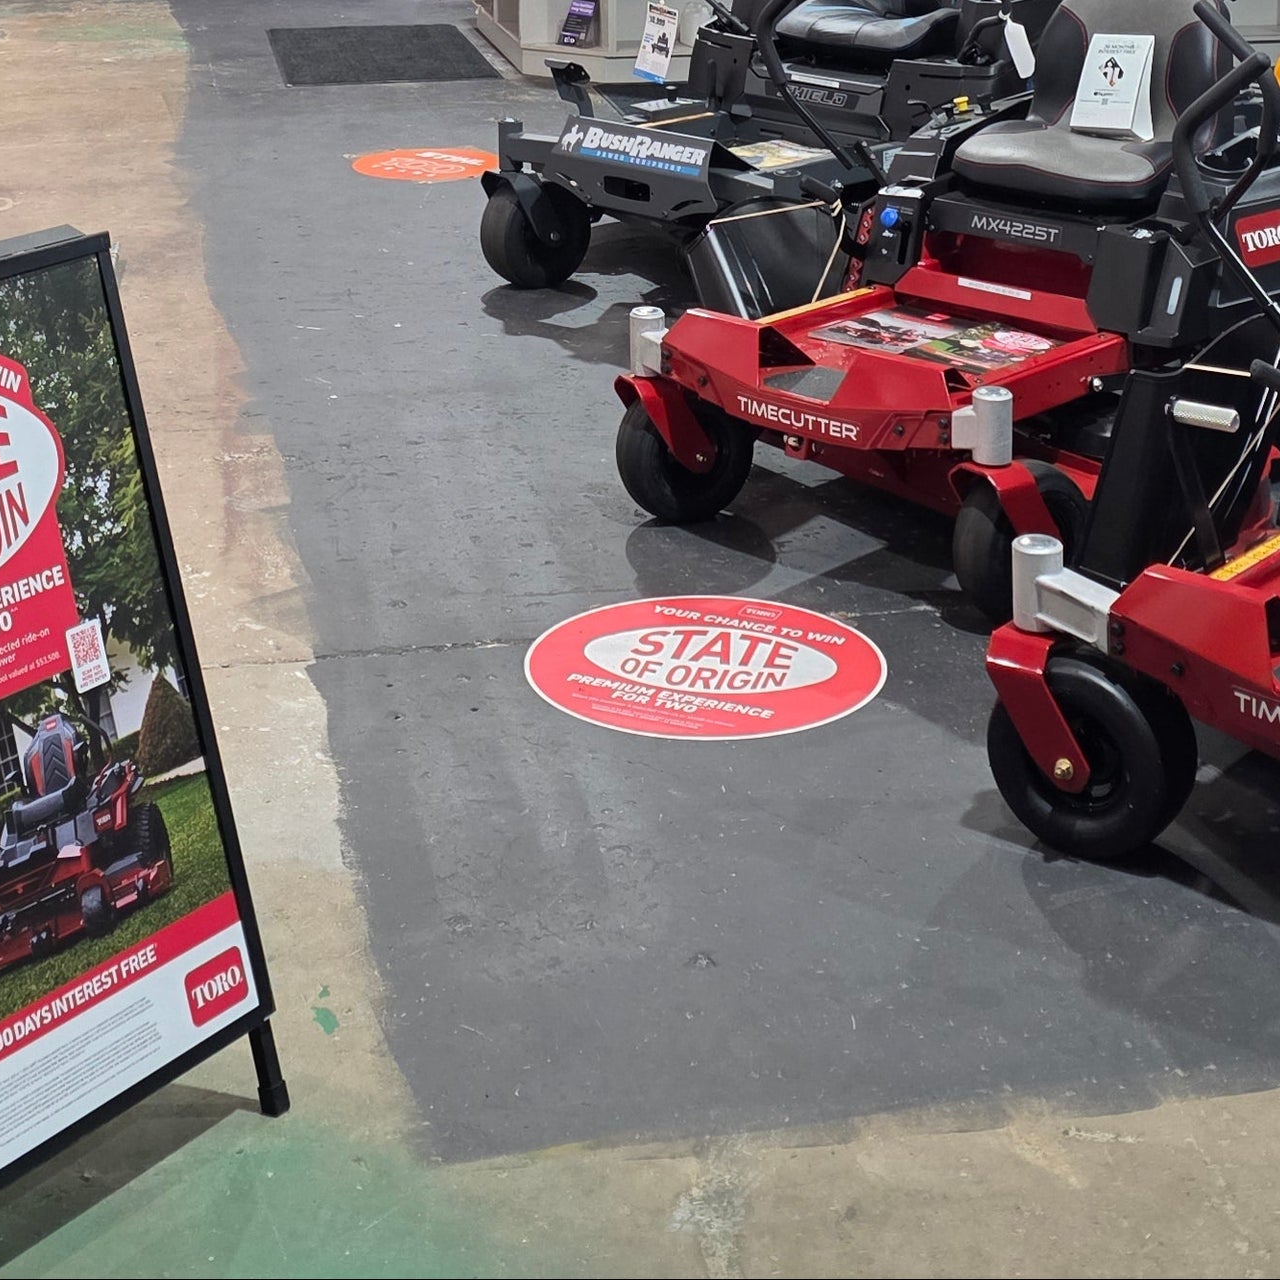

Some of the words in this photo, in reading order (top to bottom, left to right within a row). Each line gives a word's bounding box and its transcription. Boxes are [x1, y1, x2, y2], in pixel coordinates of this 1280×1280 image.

[415, 150, 486, 166] STIHL
[582, 128, 706, 166] BUSHRANGER
[971, 215, 1059, 244] MX4225T
[737, 395, 858, 441] TIMECUTTER
[21, 627, 51, 646] ride-on
[653, 604, 700, 622] YOUR
[703, 614, 775, 635] CHANCE
[780, 627, 803, 640] TO
[805, 630, 846, 646] WIN
[630, 630, 799, 671] STATE
[9, 667, 28, 682] valued
[620, 658, 661, 678] OF
[665, 664, 787, 691] ORIGIN
[566, 673, 652, 697] PREMIUM
[657, 690, 775, 720] EXPERIENCE
[611, 691, 651, 706] FOR
[15, 1005, 53, 1041] DAYS
[52, 968, 121, 1020] INTEREST
[121, 943, 157, 980] FREE
[191, 966, 243, 1008] TORO
